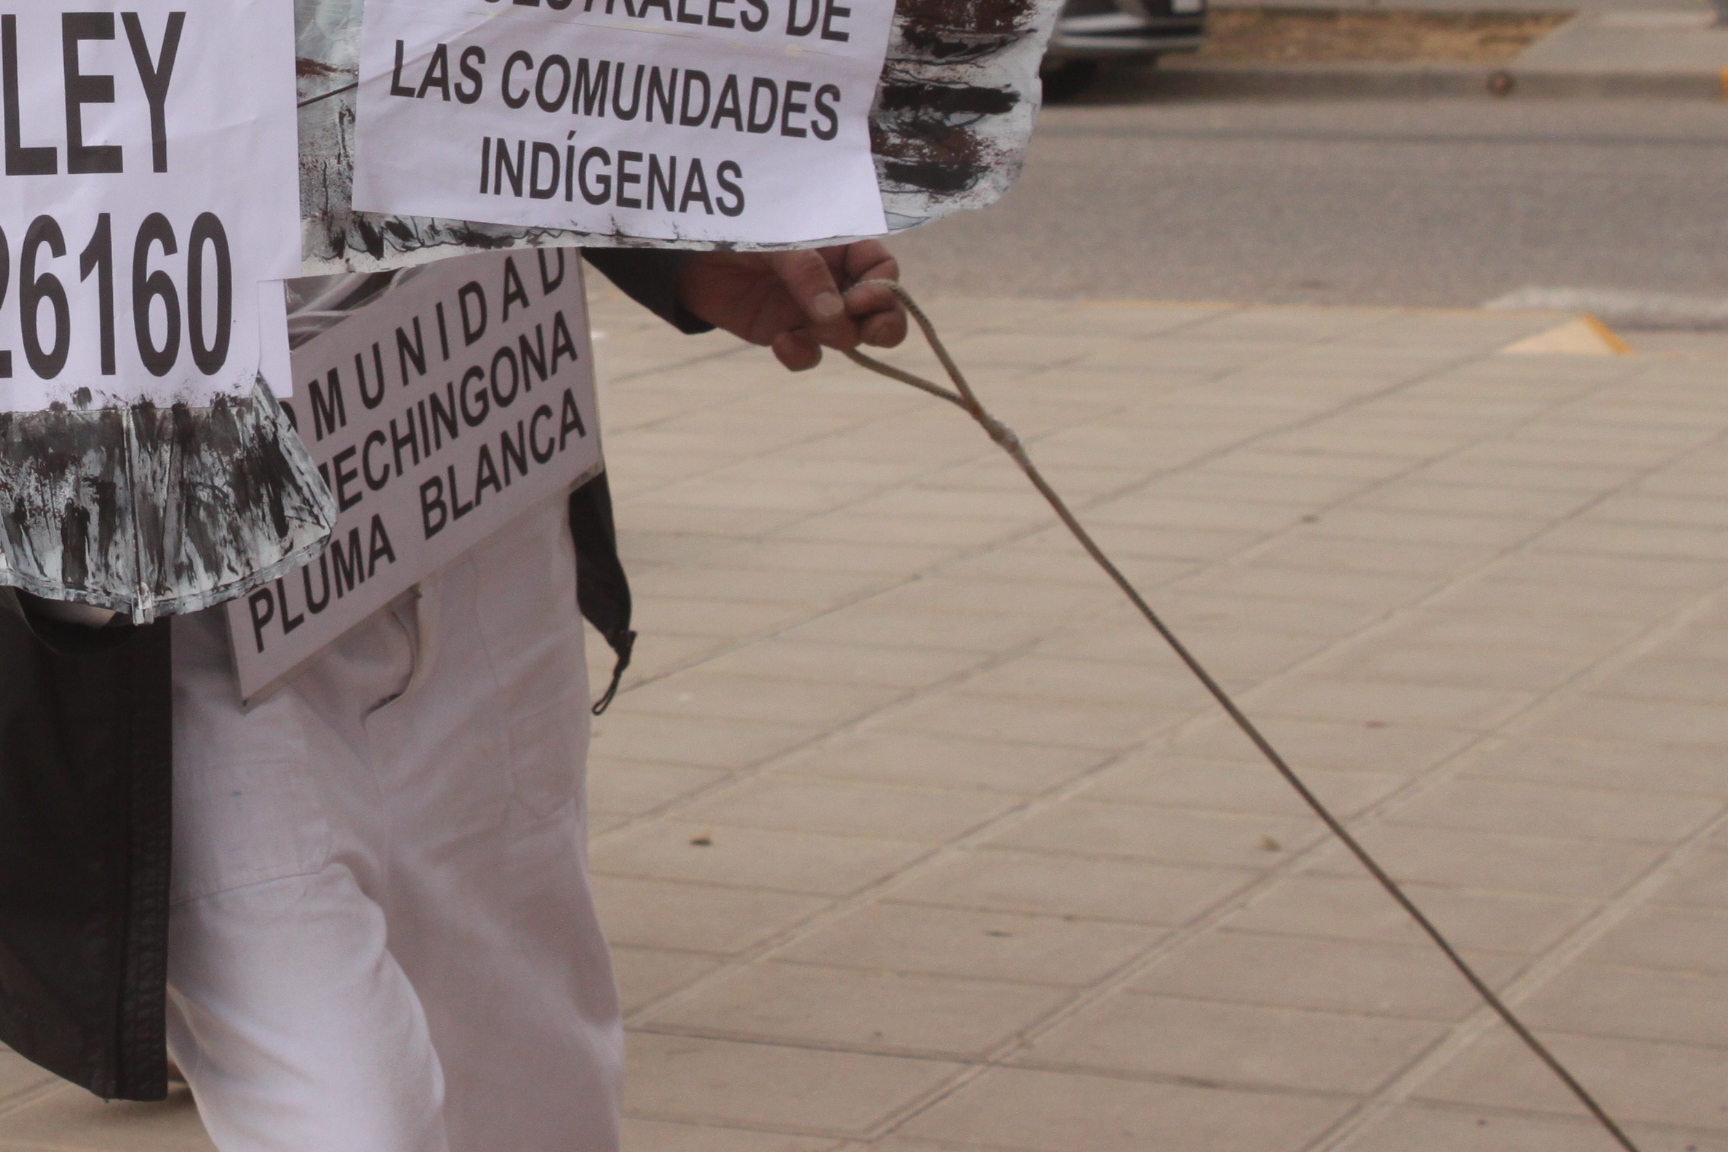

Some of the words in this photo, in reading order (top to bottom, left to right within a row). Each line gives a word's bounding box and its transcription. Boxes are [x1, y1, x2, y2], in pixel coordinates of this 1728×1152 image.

[1, 11, 186, 176] LEY
[389, 39, 486, 105] LAS
[501, 49, 841, 141] COMUNDADES
[479, 129, 745, 217] INDÍGENAS
[247, 514, 397, 654] PLUMA
[419, 388, 587, 541] BLANCA
